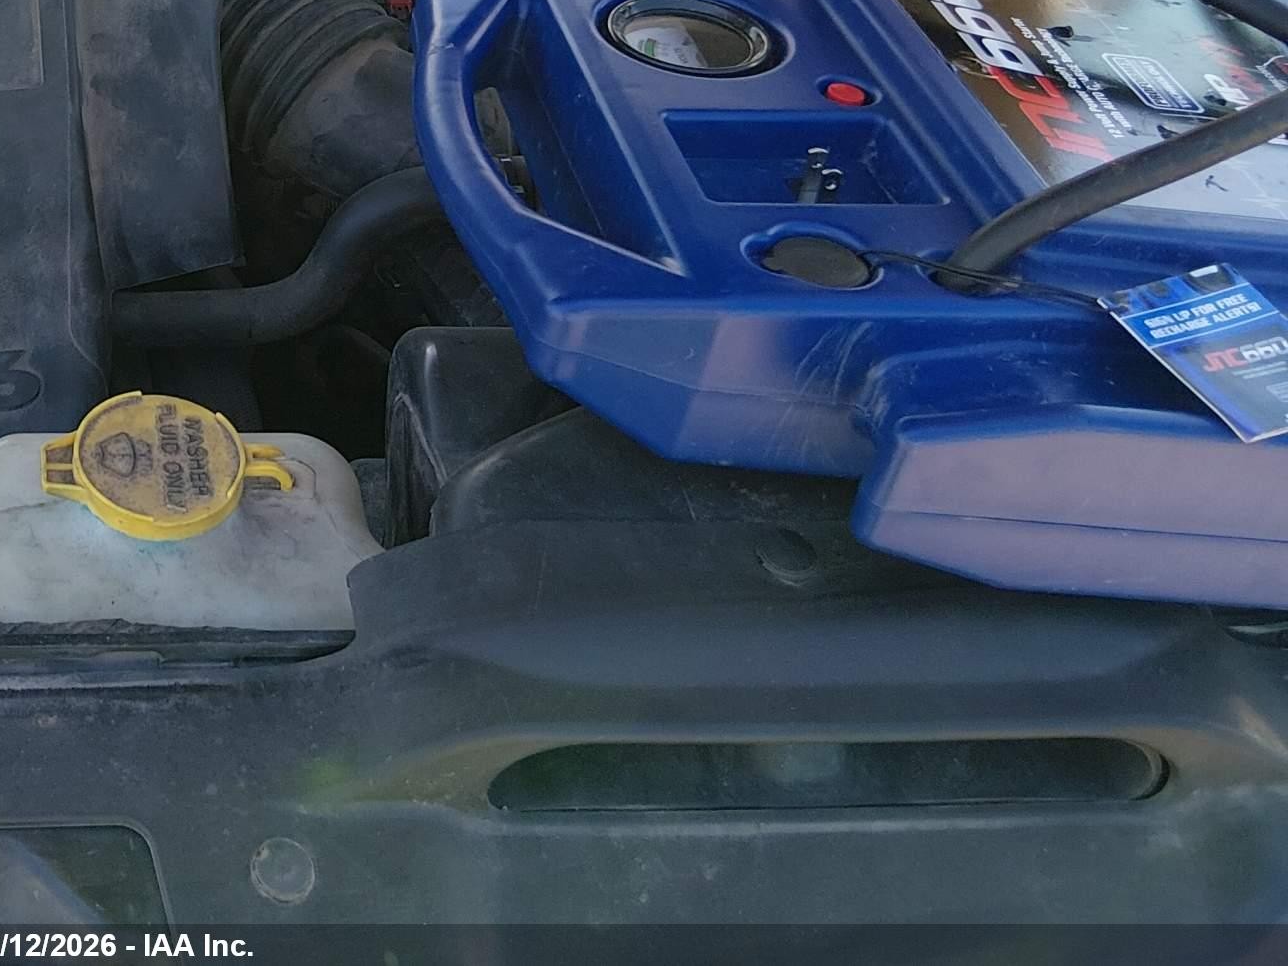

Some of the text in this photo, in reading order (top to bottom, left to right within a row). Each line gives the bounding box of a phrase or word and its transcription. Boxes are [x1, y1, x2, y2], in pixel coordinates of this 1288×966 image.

[1011, 17, 1036, 40] Starter
[1031, 39, 1054, 58] Jump
[1054, 65, 1082, 90] Supply
[1075, 89, 1103, 112] Power
[1092, 91, 1118, 111] AUTO
[1094, 113, 1116, 128] Volt
[1144, 293, 1249, 329] SIGN UP FOR FREE
[1150, 301, 1262, 339] RECHARGE ALERTS!
[155, 403, 189, 514] FLUID ONLY
[183, 414, 210, 497] WASHER
